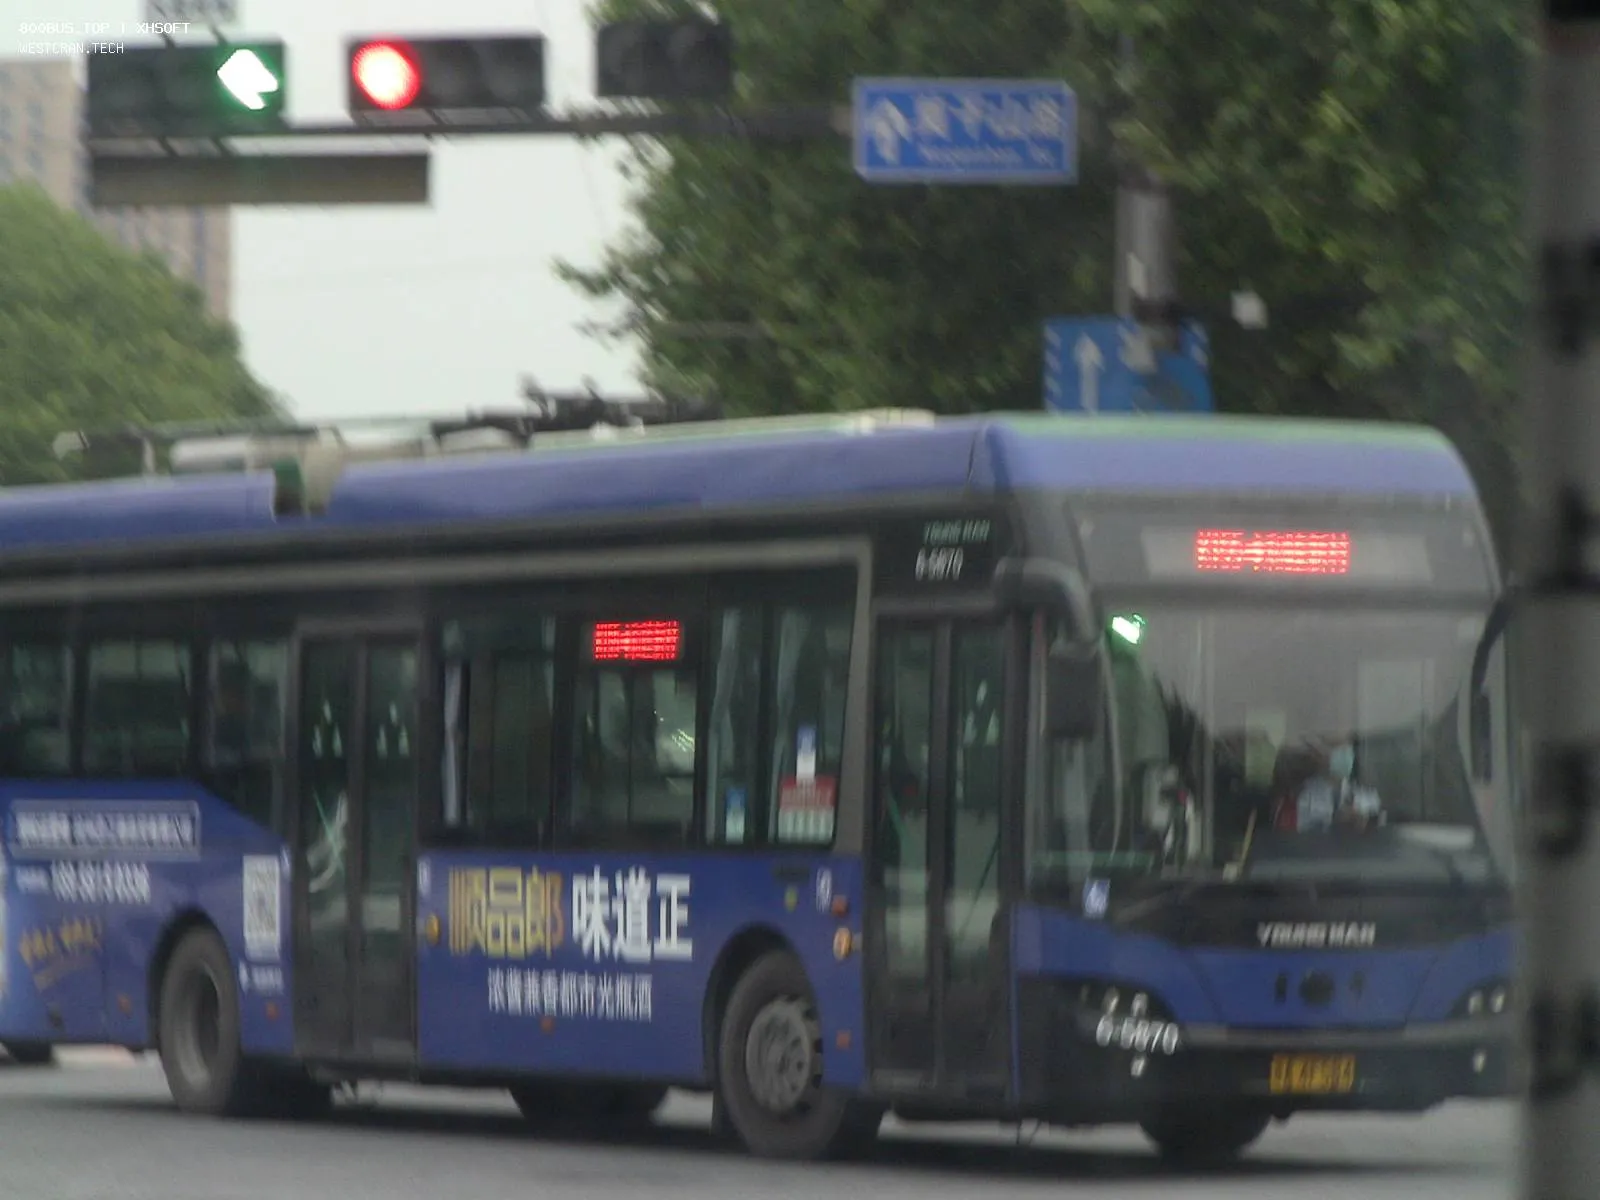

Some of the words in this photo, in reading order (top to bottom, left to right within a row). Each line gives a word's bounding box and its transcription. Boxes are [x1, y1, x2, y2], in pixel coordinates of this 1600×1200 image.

[449, 864, 564, 960] 顺品郎
[572, 864, 693, 963] 味道正
